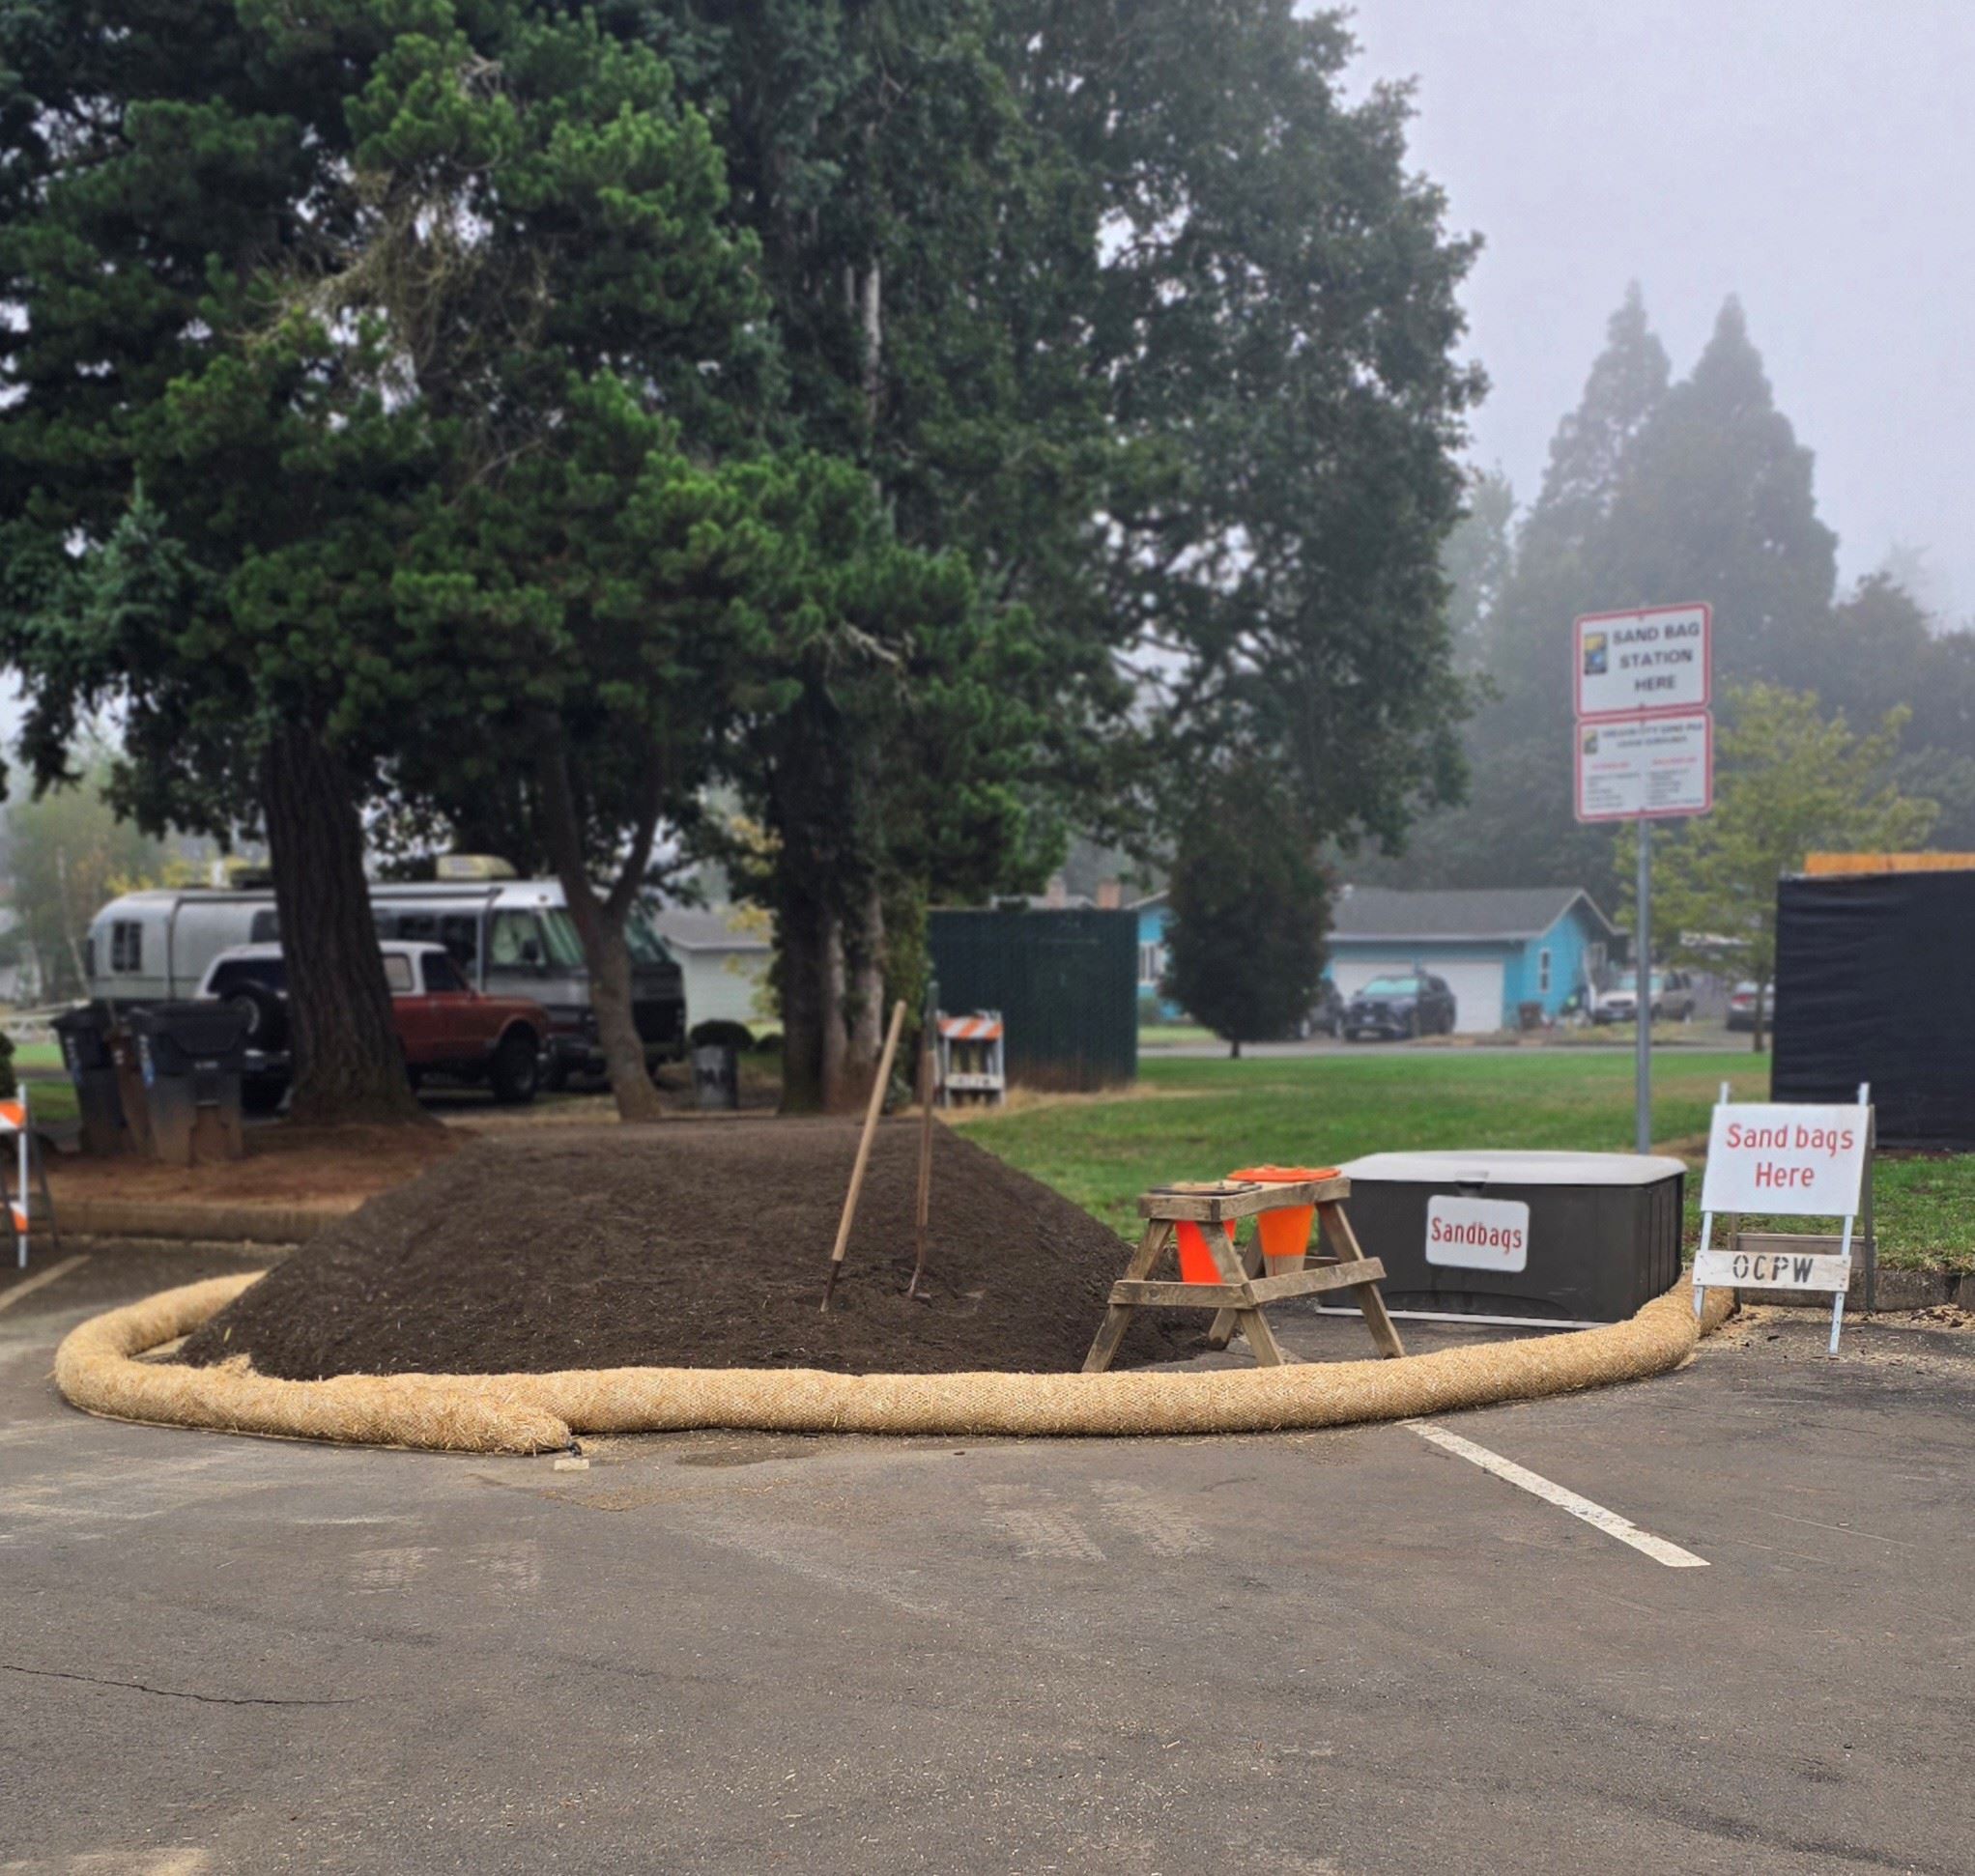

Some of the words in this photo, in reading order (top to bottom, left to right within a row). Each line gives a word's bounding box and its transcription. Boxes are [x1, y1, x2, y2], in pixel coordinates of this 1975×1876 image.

[1612, 627, 1659, 644] SAND
[1664, 621, 1700, 640] BAG
[1619, 649, 1694, 668] STATION
[1634, 674, 1675, 692] HERE
[1726, 1123, 1789, 1149] Sand
[1794, 1123, 1854, 1157] bags
[1755, 1161, 1816, 1188] Here
[1431, 1216, 1522, 1255] Sandbags
[1732, 1254, 1814, 1284] OCPW
